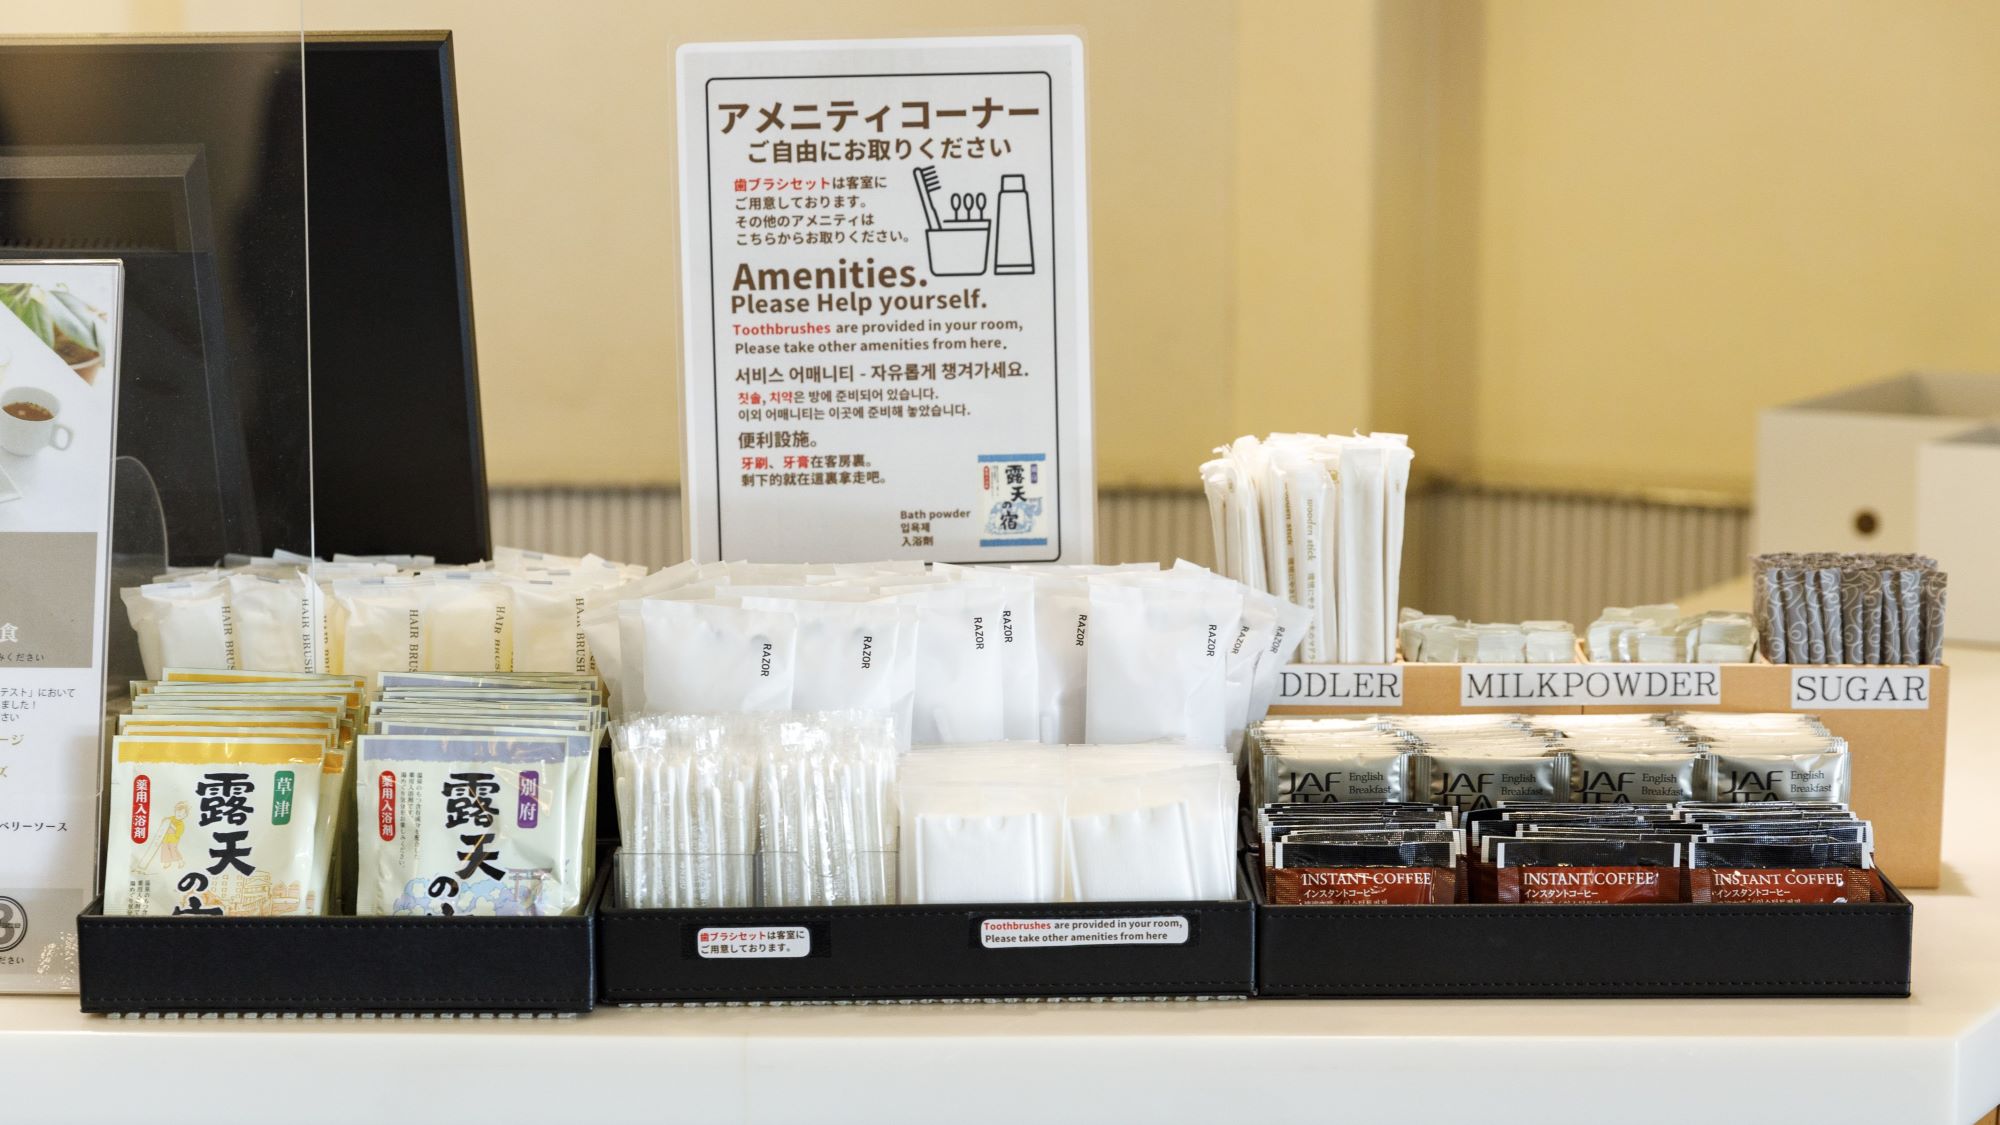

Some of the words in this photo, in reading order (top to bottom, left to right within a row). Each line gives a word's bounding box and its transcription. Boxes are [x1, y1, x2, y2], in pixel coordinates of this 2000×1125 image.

[718, 97, 1040, 134] アメニティコーナー
[748, 137, 1012, 163] ご自由にお取りください
[734, 175, 887, 192] 歯ブラシセットは客室に
[735, 195, 867, 210] ご用意しております。
[735, 214, 875, 229] その他のアメニティは
[736, 230, 909, 246] こちらからお取りください。
[732, 257, 928, 291] Amenities.
[731, 294, 810, 314] Please
[817, 291, 873, 316] Help
[879, 288, 987, 316] yourself.
[732, 323, 831, 336] Toothbrushes
[835, 323, 859, 334] are
[862, 319, 926, 336] provided
[928, 319, 942, 331] in
[945, 320, 978, 333] your
[980, 319, 1024, 332] room,
[735, 343, 781, 355] Please
[783, 341, 815, 353] take
[818, 340, 857, 352] other
[860, 338, 930, 351] amenities
[932, 337, 967, 350] from
[970, 337, 1008, 350] here.
[735, 367, 784, 384] 서비스
[789, 365, 854, 383] 어매니티
[870, 363, 937, 382] 자유롭게
[941, 361, 1030, 381] 챙겨가세요.
[738, 391, 767, 406] 칫솔,
[769, 390, 806, 404] 치약은
[809, 389, 832, 403] 방에
[836, 389, 883, 402] 준비되어
[886, 387, 940, 401] 있습니다.
[738, 408, 762, 422] 이외
[765, 407, 825, 421] 어매니티는
[828, 406, 864, 420] 이곳에
[867, 405, 904, 419] 준비해
[907, 403, 972, 418] 놓았습니다.
[738, 431, 817, 449] 便利設施。
[1000, 464, 1027, 530] 露天の宿
[900, 509, 926, 520] Bath
[929, 509, 972, 520] powder
[900, 522, 931, 534] 입욕제
[1307, 540, 1317, 561] stick
[221, 606, 234, 637] HAIR
[302, 598, 310, 629] HAIR
[409, 609, 419, 639] HAIR
[494, 606, 506, 634] HAIR
[576, 598, 585, 627] HA
[973, 617, 985, 650] RAZOR
[1002, 610, 1013, 643] RAZOR
[1075, 614, 1088, 647] RAZOR
[1206, 624, 1218, 657] RAZOR
[1231, 625, 1250, 655] RAZOR
[1270, 625, 1286, 655] RAZOR
[303, 634, 314, 675] BRUSH
[576, 632, 586, 673] BRUSH
[760, 643, 772, 677] RAZOR
[861, 636, 873, 669] RAZOR
[1280, 672, 1401, 698] DDLER
[1467, 671, 1719, 698] MILKPOWDER
[1796, 675, 1928, 702] SUGAR
[1283, 771, 1342, 795] JAF
[1349, 772, 1384, 783] English
[1434, 772, 1495, 796] JAF
[1501, 773, 1537, 784] English
[1574, 771, 1635, 794] JAF
[1642, 773, 1677, 784] English
[1722, 771, 1783, 794] JAF
[1790, 770, 1825, 780] English
[274, 777, 293, 818] 草津
[519, 777, 537, 821] 別府
[1349, 784, 1392, 795] Breakfast
[1501, 786, 1544, 796] Breakfast
[1642, 785, 1684, 796] Breakfast
[1790, 782, 1832, 793] Breakfast
[133, 779, 148, 839] 薬用入浴剤
[381, 775, 394, 836] 薬用入浴剤
[427, 772, 506, 916] 露天の
[1301, 872, 1370, 885] INSTANT
[1373, 872, 1432, 885] COFFEE
[1523, 872, 1589, 885] INSTANT
[1594, 872, 1654, 885] COFFEE
[1715, 873, 1781, 886] INSTANT
[1785, 873, 1843, 885] COFFEE
[1525, 889, 1598, 898] インスタントコーヒー
[1717, 888, 1791, 898] インスタントコーヒー
[700, 930, 805, 942] 歯ブラシセットは客室に
[984, 921, 1051, 931] Toothbrushes
[1054, 921, 1070, 929] are
[1072, 919, 1116, 931] provided
[1118, 919, 1127, 928] in
[1129, 920, 1151, 930] your
[1153, 919, 1183, 929] room,
[701, 943, 791, 954] ご用意しております。
[985, 934, 1016, 943] Please
[1019, 933, 1040, 942] take
[1042, 933, 1068, 942] other
[1070, 932, 1118, 941] amenities
[1120, 931, 1144, 941] from
[1146, 931, 1168, 940] here
